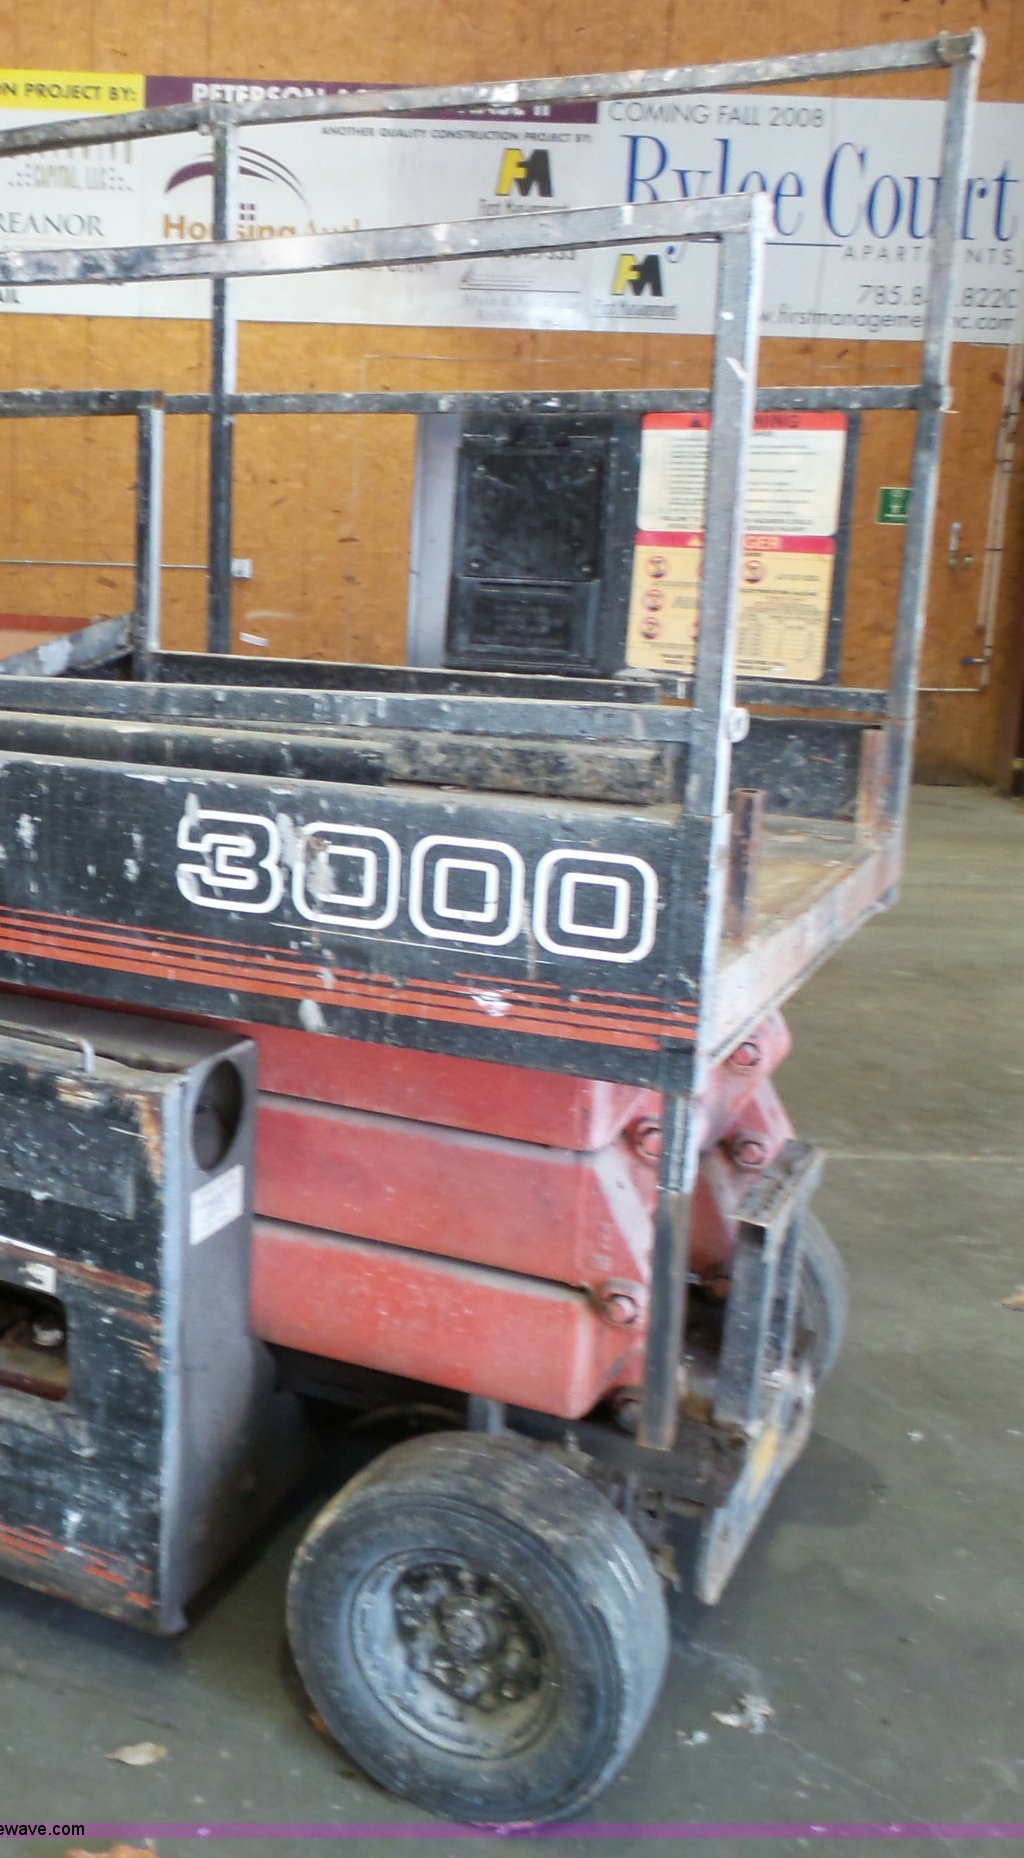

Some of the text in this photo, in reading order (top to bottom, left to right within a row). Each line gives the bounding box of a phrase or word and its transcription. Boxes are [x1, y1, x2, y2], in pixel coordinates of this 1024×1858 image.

[25, 82, 102, 100] PROJECT
[108, 86, 139, 102] BY:
[609, 101, 826, 129] COMING FALL 2008
[321, 126, 375, 137] ANOTHER
[379, 127, 426, 138] QUALITY
[431, 129, 520, 141] CONSTRUCTION
[525, 131, 571, 143] PROJECT
[163, 213, 297, 241] Hosing
[843, 245, 1014, 266] APARTNTS
[176, 808, 660, 965] 3000
